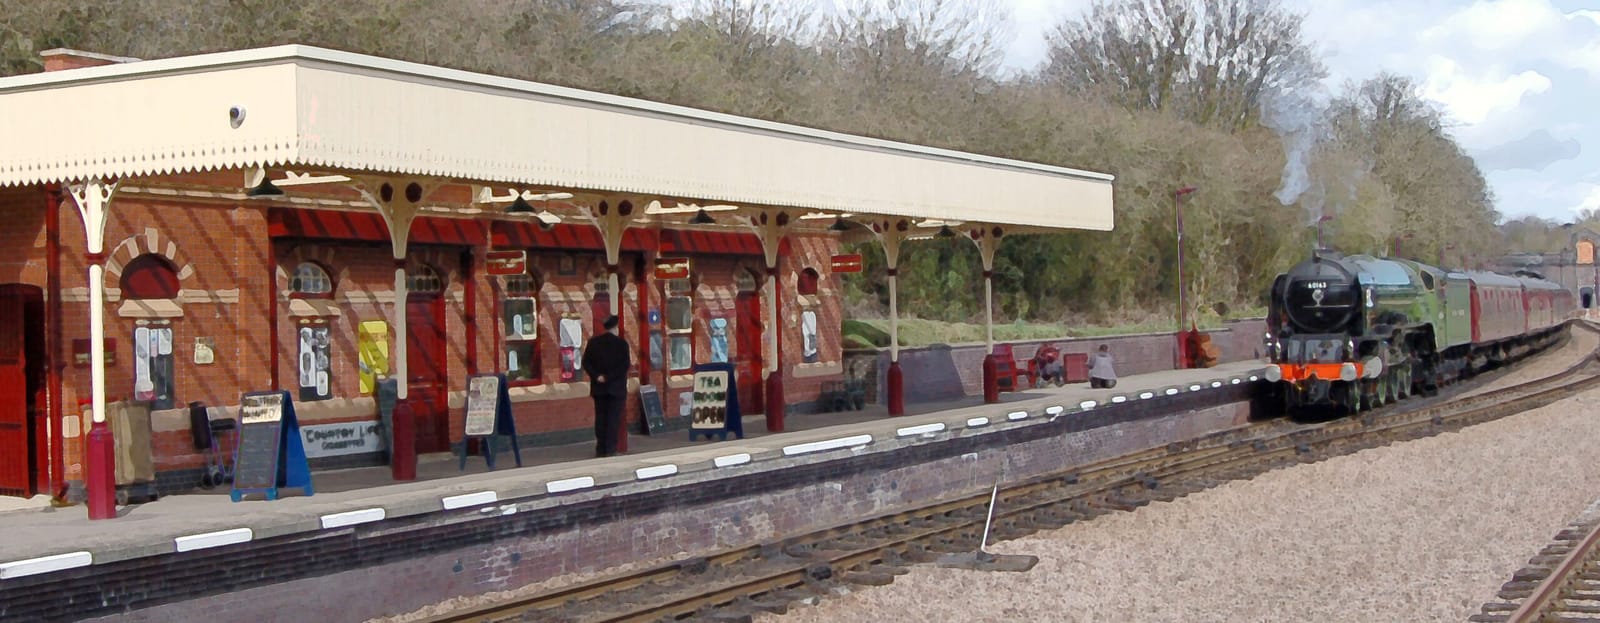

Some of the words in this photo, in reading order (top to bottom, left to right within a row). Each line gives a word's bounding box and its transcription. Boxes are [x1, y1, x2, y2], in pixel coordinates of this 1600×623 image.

[1307, 281, 1327, 289] 60163
[699, 376, 722, 388] TEA
[693, 406, 725, 425] OPEN
